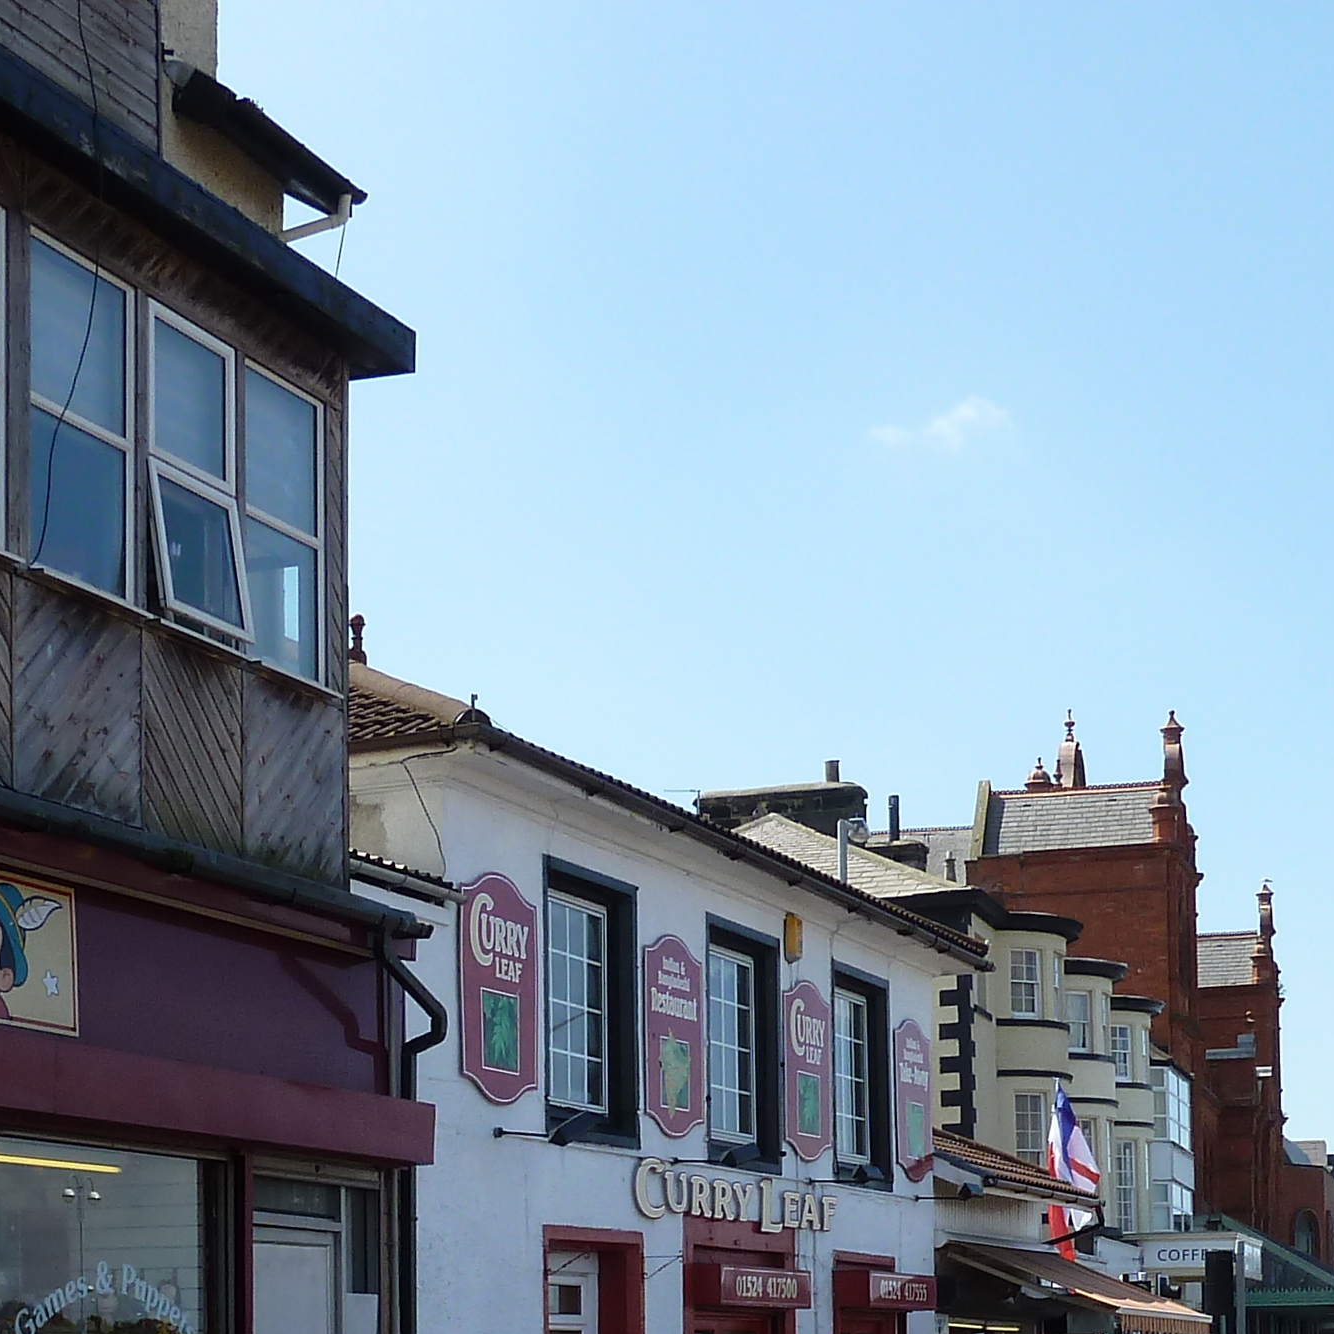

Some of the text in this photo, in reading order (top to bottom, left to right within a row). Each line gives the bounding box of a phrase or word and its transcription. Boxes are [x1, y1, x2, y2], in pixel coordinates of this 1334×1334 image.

[469, 892, 529, 967] CURRY
[494, 953, 523, 985] LEAF
[651, 986, 698, 1022] Restaurant
[789, 998, 826, 1057] CURRY
[805, 1042, 823, 1067] LEAF
[634, 1156, 839, 1234] CURRY LEAF
[94, 1260, 115, 1296] &
[735, 1274, 798, 1300] 01524 417500
[879, 1279, 928, 1303] 01524 417555
